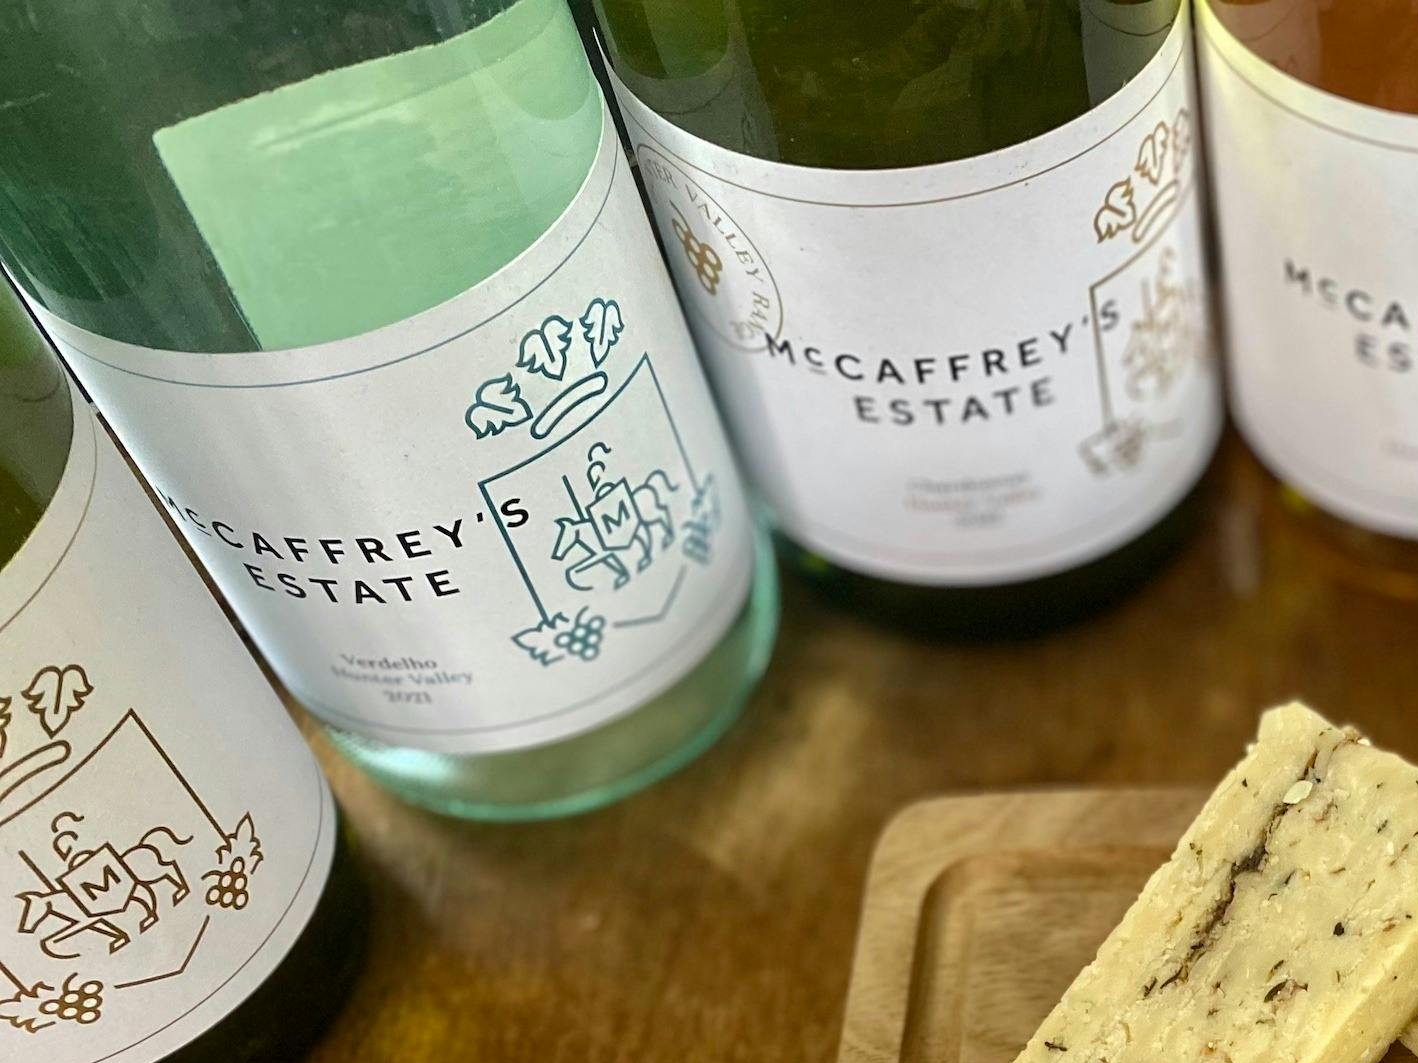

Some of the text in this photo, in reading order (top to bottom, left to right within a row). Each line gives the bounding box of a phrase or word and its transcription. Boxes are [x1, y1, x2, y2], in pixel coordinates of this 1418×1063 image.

[685, 184, 764, 283] VALLEY
[853, 376, 1056, 426] ESTATE
[243, 563, 461, 605] ESTATE
[340, 653, 438, 670] Verdelho
[408, 671, 474, 686] Valley
